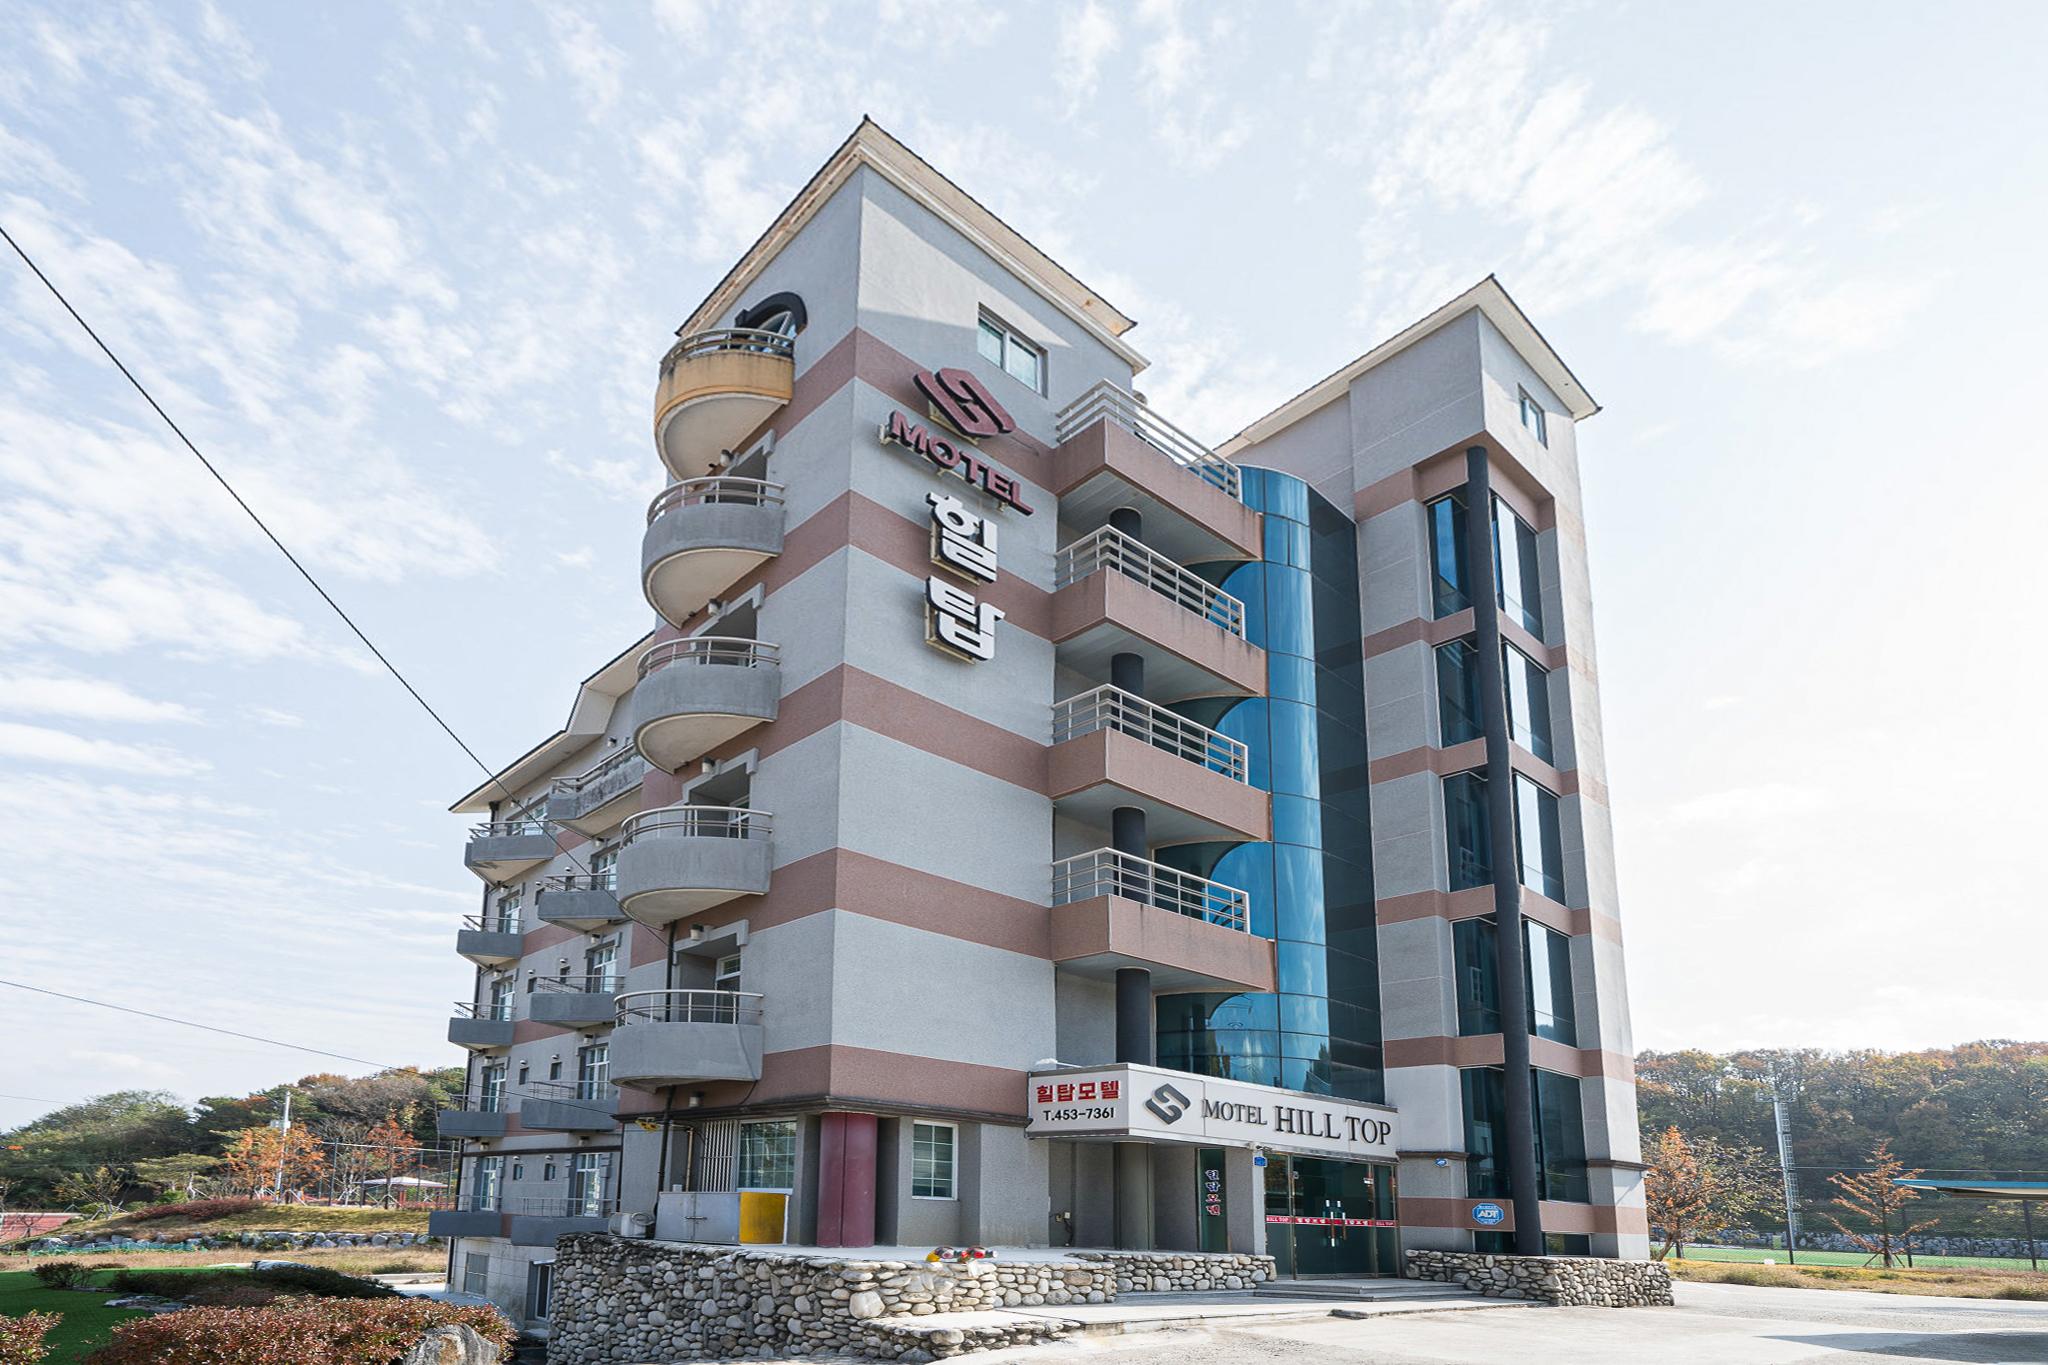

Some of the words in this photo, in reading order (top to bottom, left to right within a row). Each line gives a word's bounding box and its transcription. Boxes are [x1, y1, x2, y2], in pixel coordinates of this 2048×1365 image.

[889, 409, 1034, 516] MOTEL
[925, 491, 1006, 661] 힐탑
[1036, 1080, 1119, 1104] 힐탑모텔
[1043, 1107, 1114, 1121] T.453-7361
[1202, 1099, 1267, 1126] MOTEL
[1274, 1105, 1341, 1140] HILL
[1345, 1116, 1391, 1145] TOP
[1477, 1209, 1498, 1219] ADT
